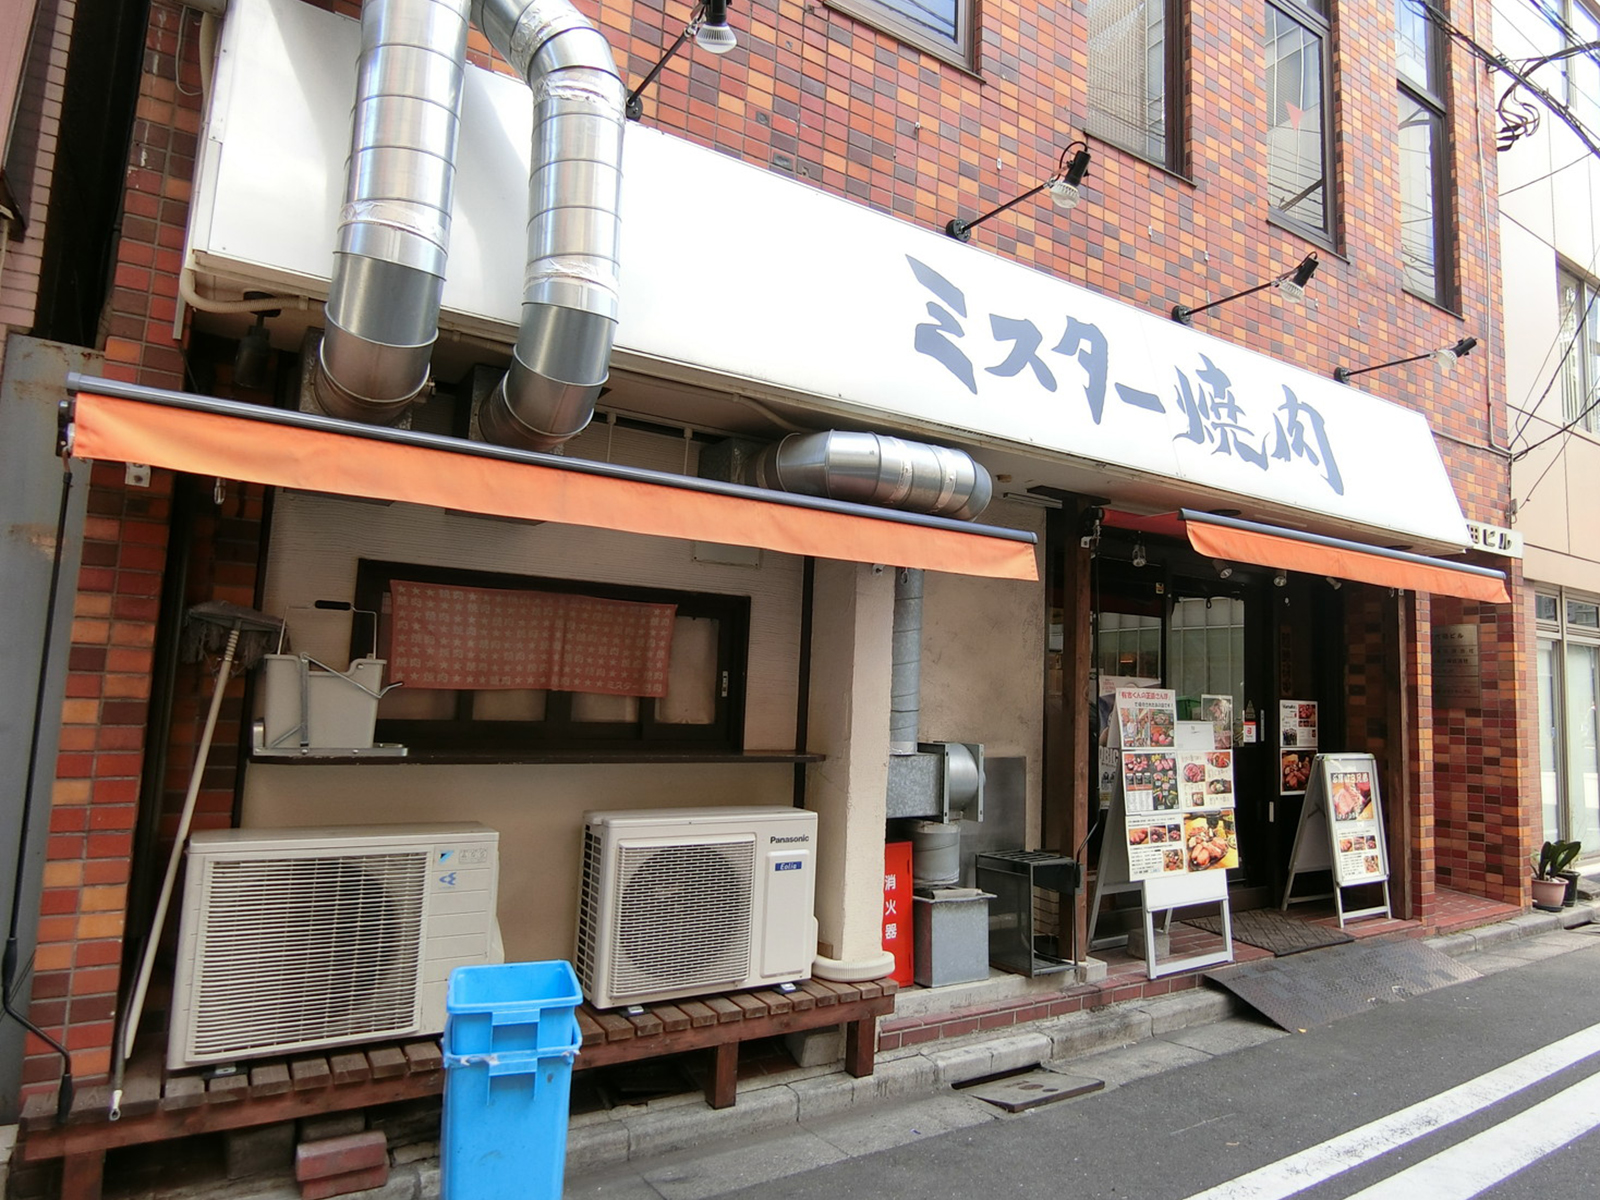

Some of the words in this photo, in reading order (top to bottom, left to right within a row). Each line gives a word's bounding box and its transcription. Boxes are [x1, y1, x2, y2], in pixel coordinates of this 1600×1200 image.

[905, 254, 1344, 496] ミスター焼肉
[770, 834, 809, 844] Panasonic
[885, 874, 898, 940] 消火器
